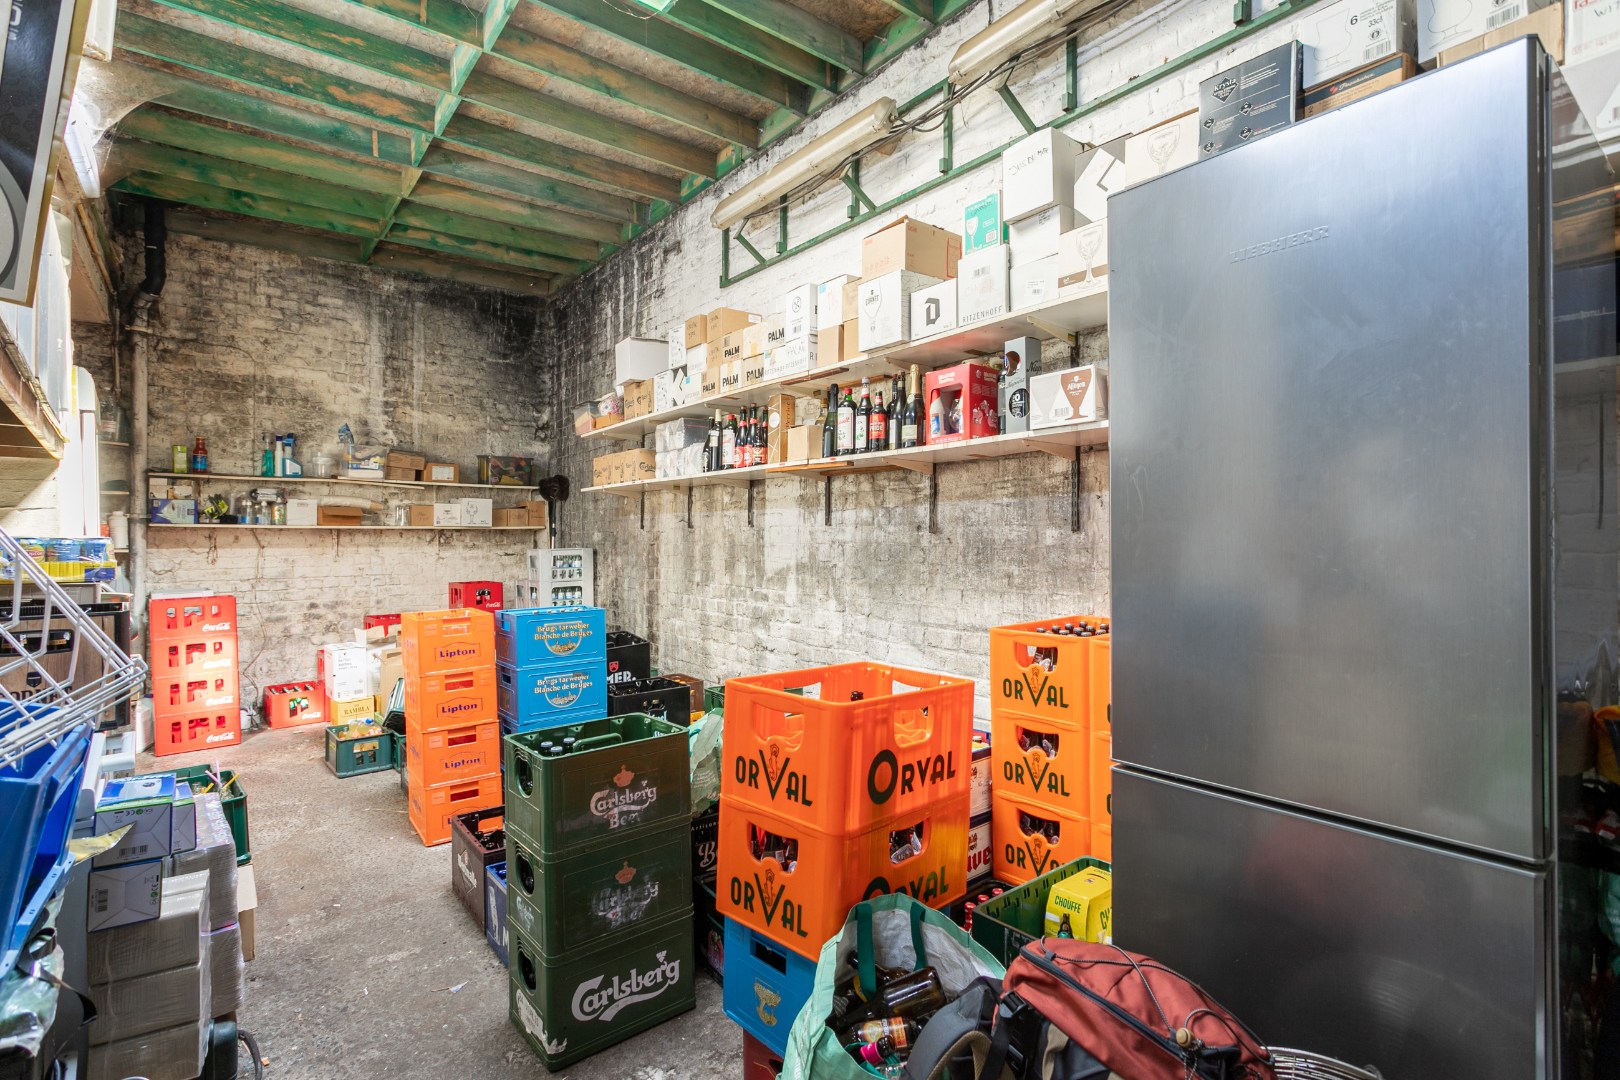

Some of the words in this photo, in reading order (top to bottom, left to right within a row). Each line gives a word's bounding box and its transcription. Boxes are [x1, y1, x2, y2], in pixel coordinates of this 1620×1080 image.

[1350, 15, 1358, 26] 6
[962, 306, 1002, 323] RITZENHOFF
[768, 328, 785, 343] PALM
[725, 346, 740, 358] PALM
[703, 382, 716, 393] PALM
[722, 374, 739, 388] PALM
[440, 649, 476, 658] Lipton
[1003, 672, 1069, 708] ORVAL
[442, 703, 478, 714] Lipton
[445, 758, 480, 768] Lipton
[735, 749, 813, 807] ORVAL
[867, 749, 956, 805] ORVAL
[1004, 756, 1070, 797] ORVAL
[590, 785, 657, 818] Carlsberg
[731, 872, 808, 938] ORVAL
[1054, 895, 1082, 914] CHOUFFE
[571, 955, 681, 1021] Carlsberg
